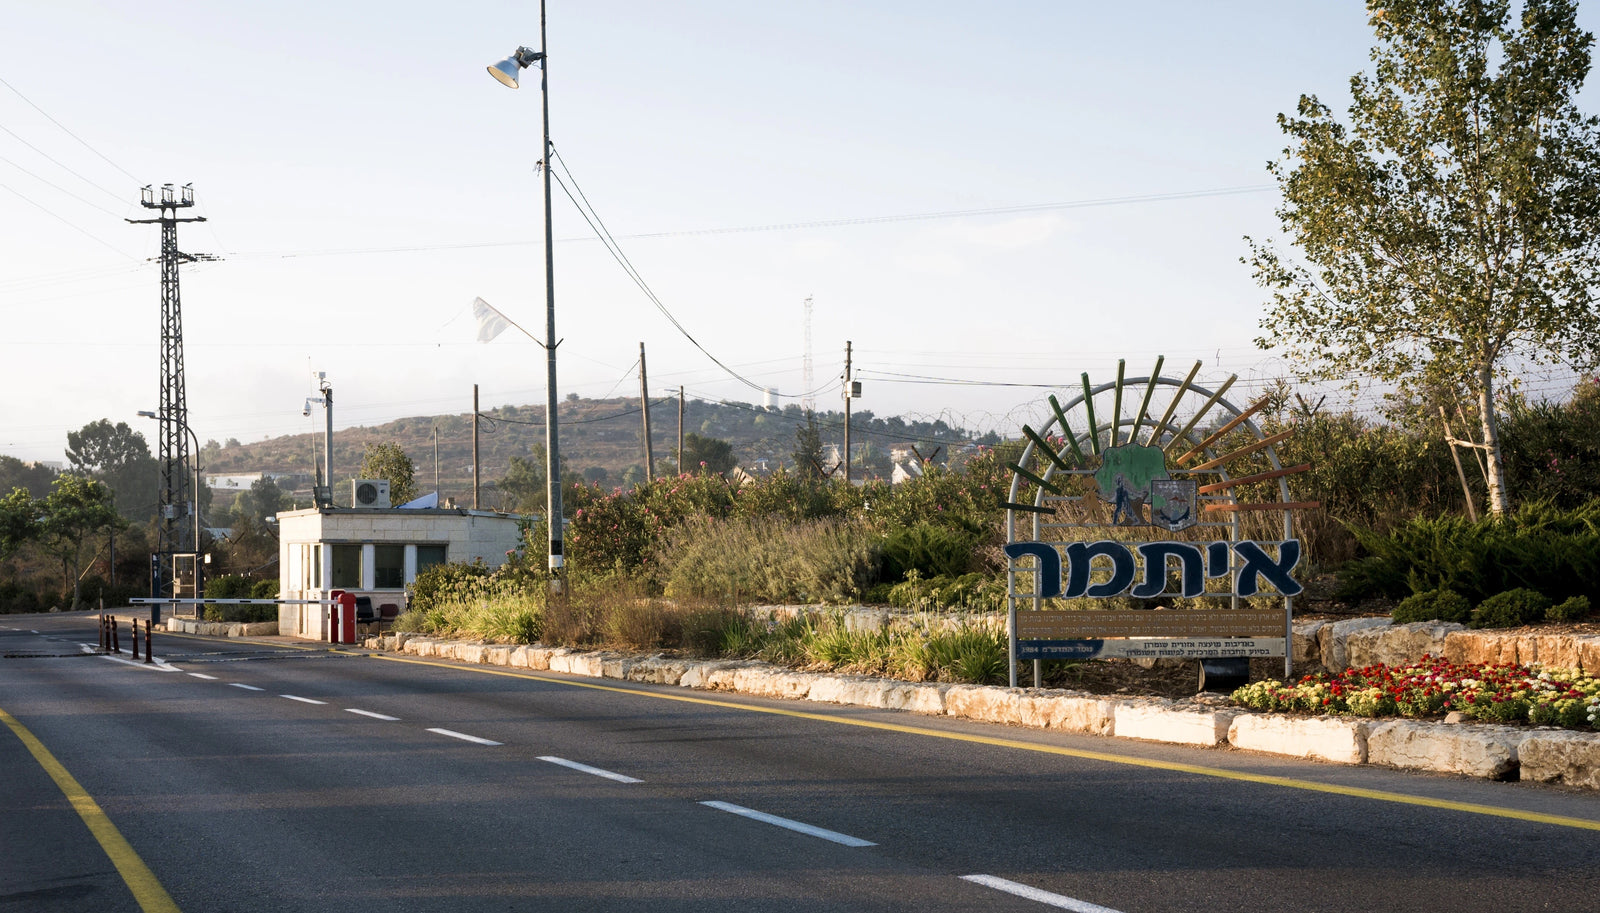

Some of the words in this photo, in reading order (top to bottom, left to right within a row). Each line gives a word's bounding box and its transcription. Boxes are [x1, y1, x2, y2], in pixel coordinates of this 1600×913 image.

[1004, 539, 1304, 598] איתמר
[1144, 641, 1168, 650] שומרון
[1198, 641, 1222, 649] מועצה
[1125, 648, 1156, 658] השומרון
[1159, 648, 1185, 656] לפיתוח
[1221, 648, 1247, 656] החברה
[1248, 648, 1270, 656] בסיוע
